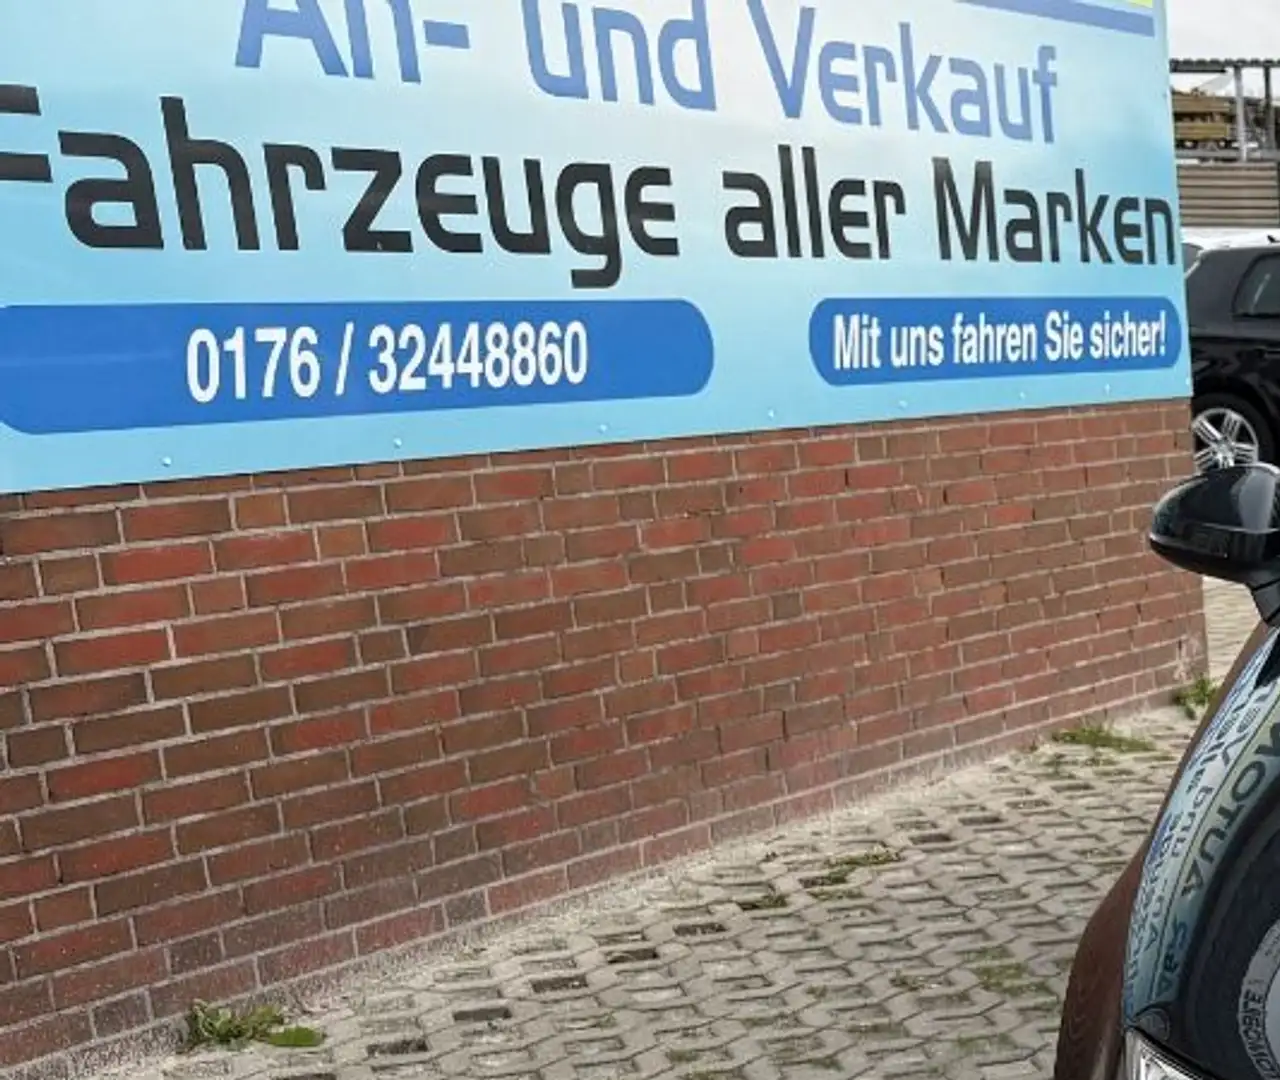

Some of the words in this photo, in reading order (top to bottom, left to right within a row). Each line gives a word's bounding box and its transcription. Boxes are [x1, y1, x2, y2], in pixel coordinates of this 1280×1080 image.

[520, 0, 717, 112] und
[740, 0, 1058, 144] Verkauf
[722, 144, 906, 260] aller
[932, 156, 1176, 265] Marken
[186, 326, 320, 402] 0176
[368, 320, 588, 394] 32448860
[833, 312, 881, 370] Mit
[890, 322, 944, 368] uns
[952, 315, 1037, 364] fahren
[1045, 309, 1083, 362] Sie
[1089, 310, 1167, 358] sicher!
